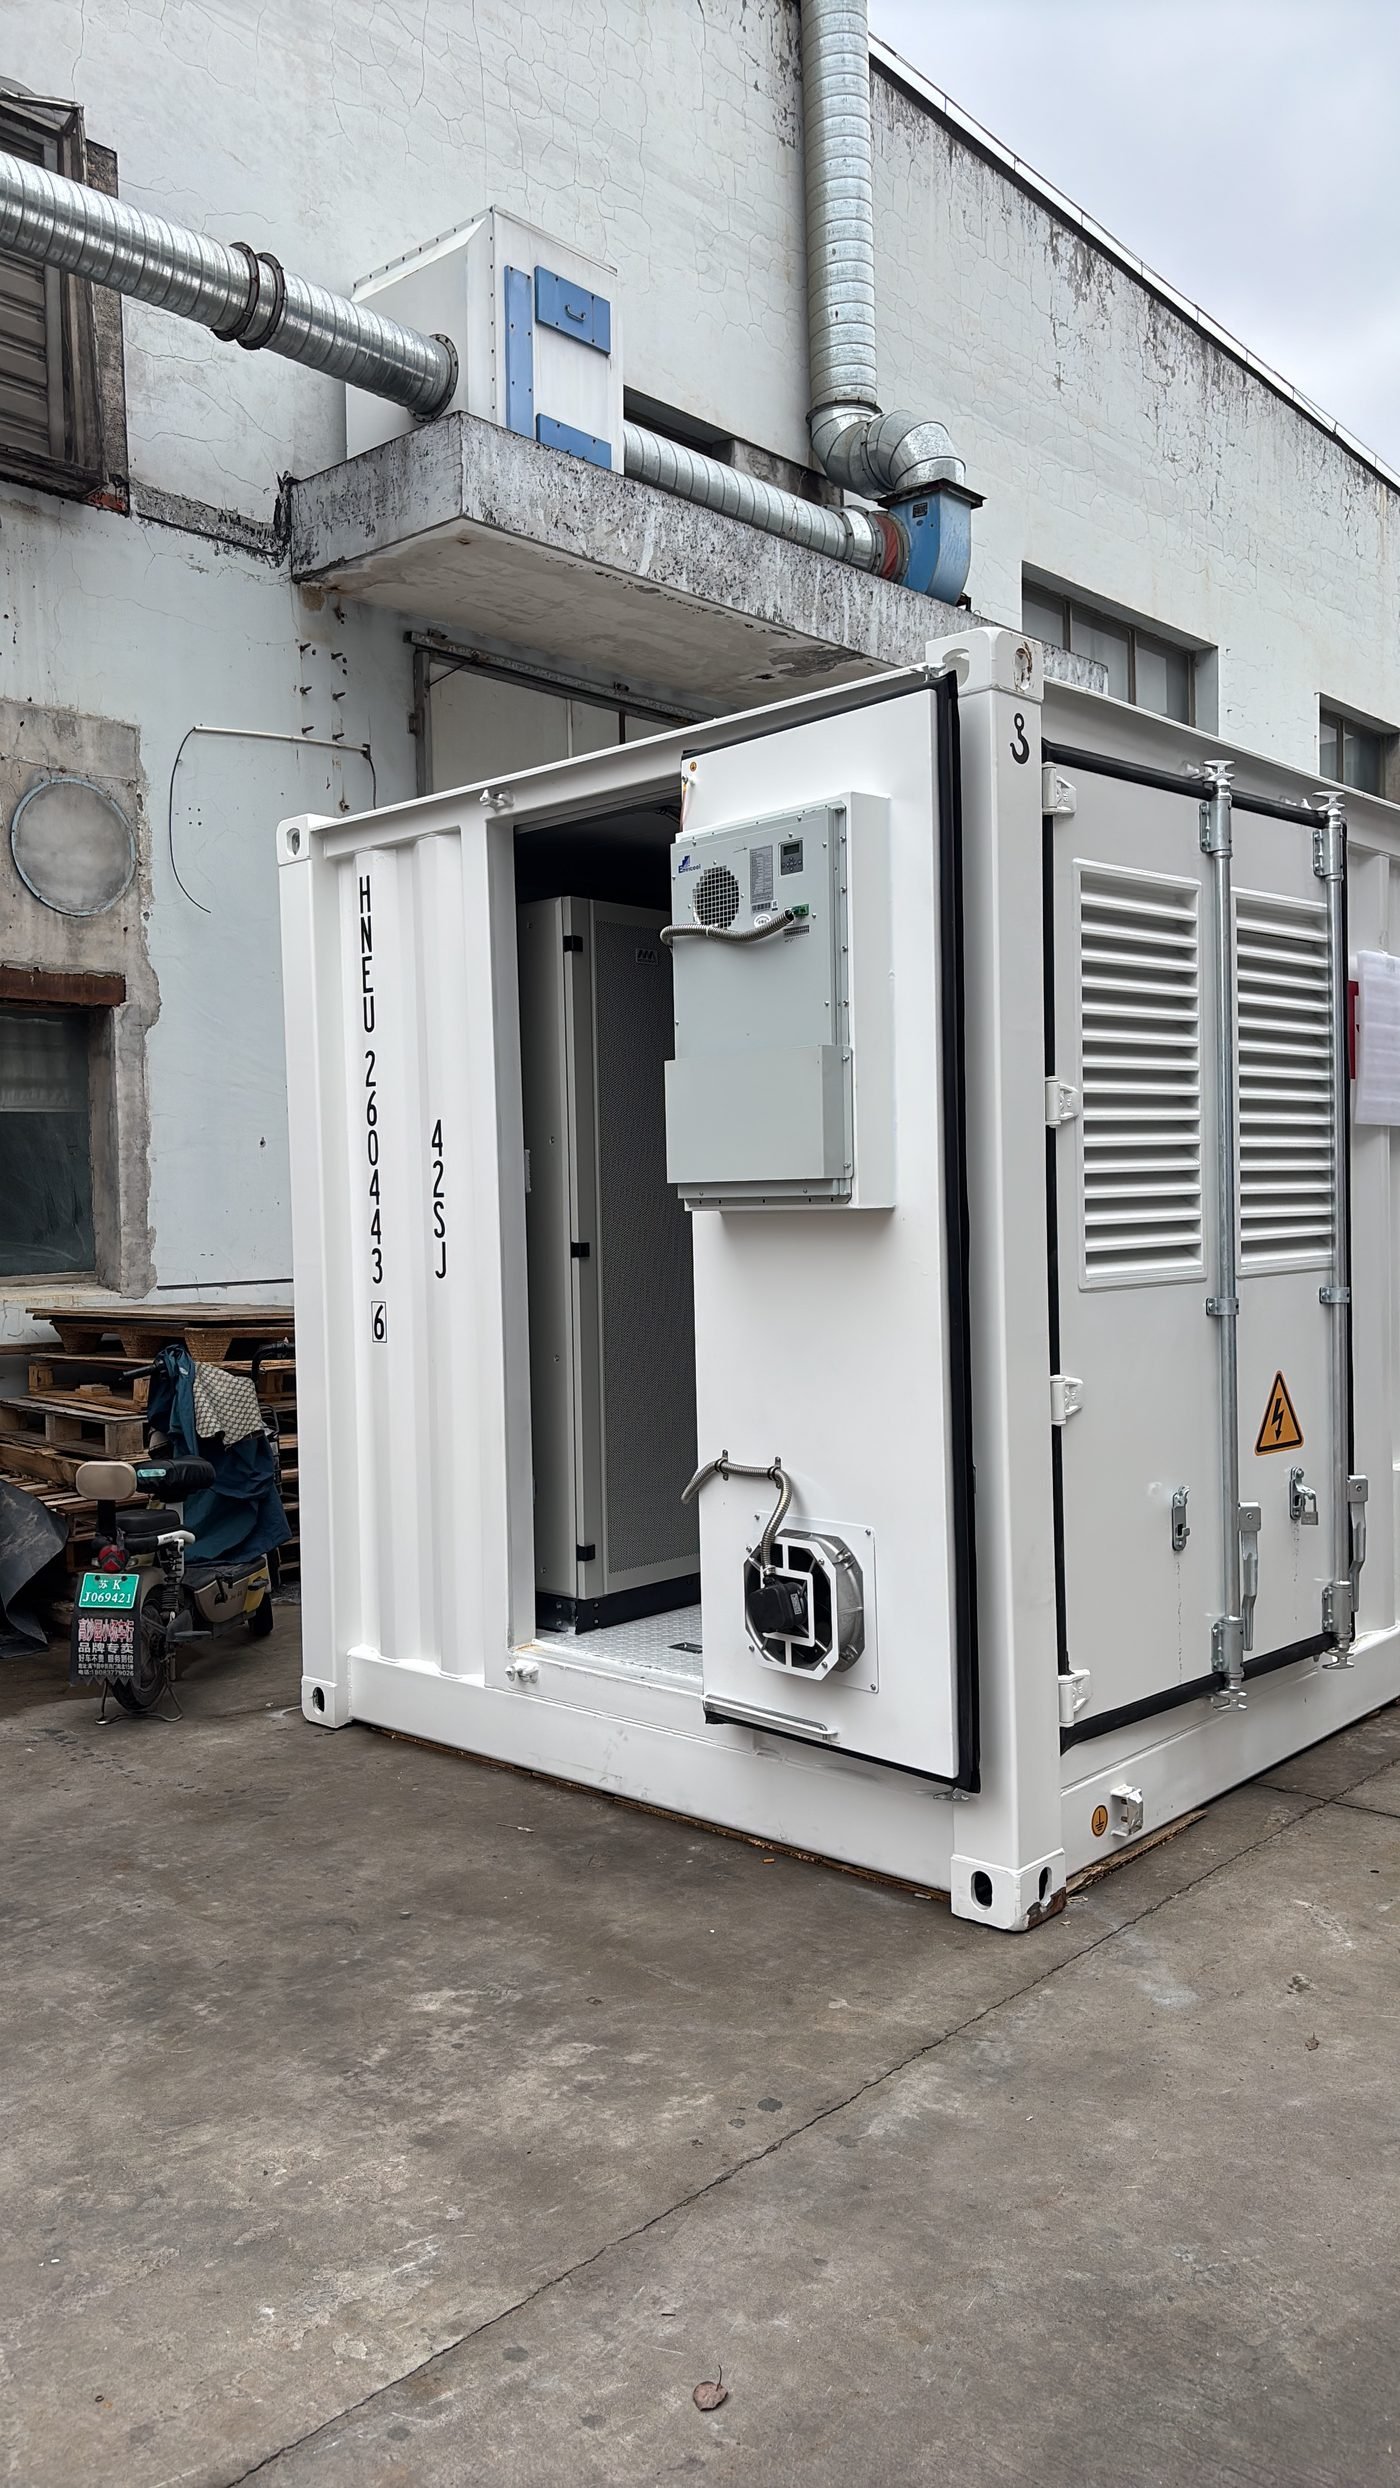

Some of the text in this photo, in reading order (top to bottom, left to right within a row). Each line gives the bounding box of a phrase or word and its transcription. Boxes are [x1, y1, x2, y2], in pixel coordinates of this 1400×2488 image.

[360, 875, 384, 1339] HNEU 260443 6
[432, 1120, 446, 1278] 42SJ
[98, 1580, 120, 1589] 苏 K
[82, 1592, 131, 1603] J069421
[78, 1643, 134, 1654] 品牌专卖
